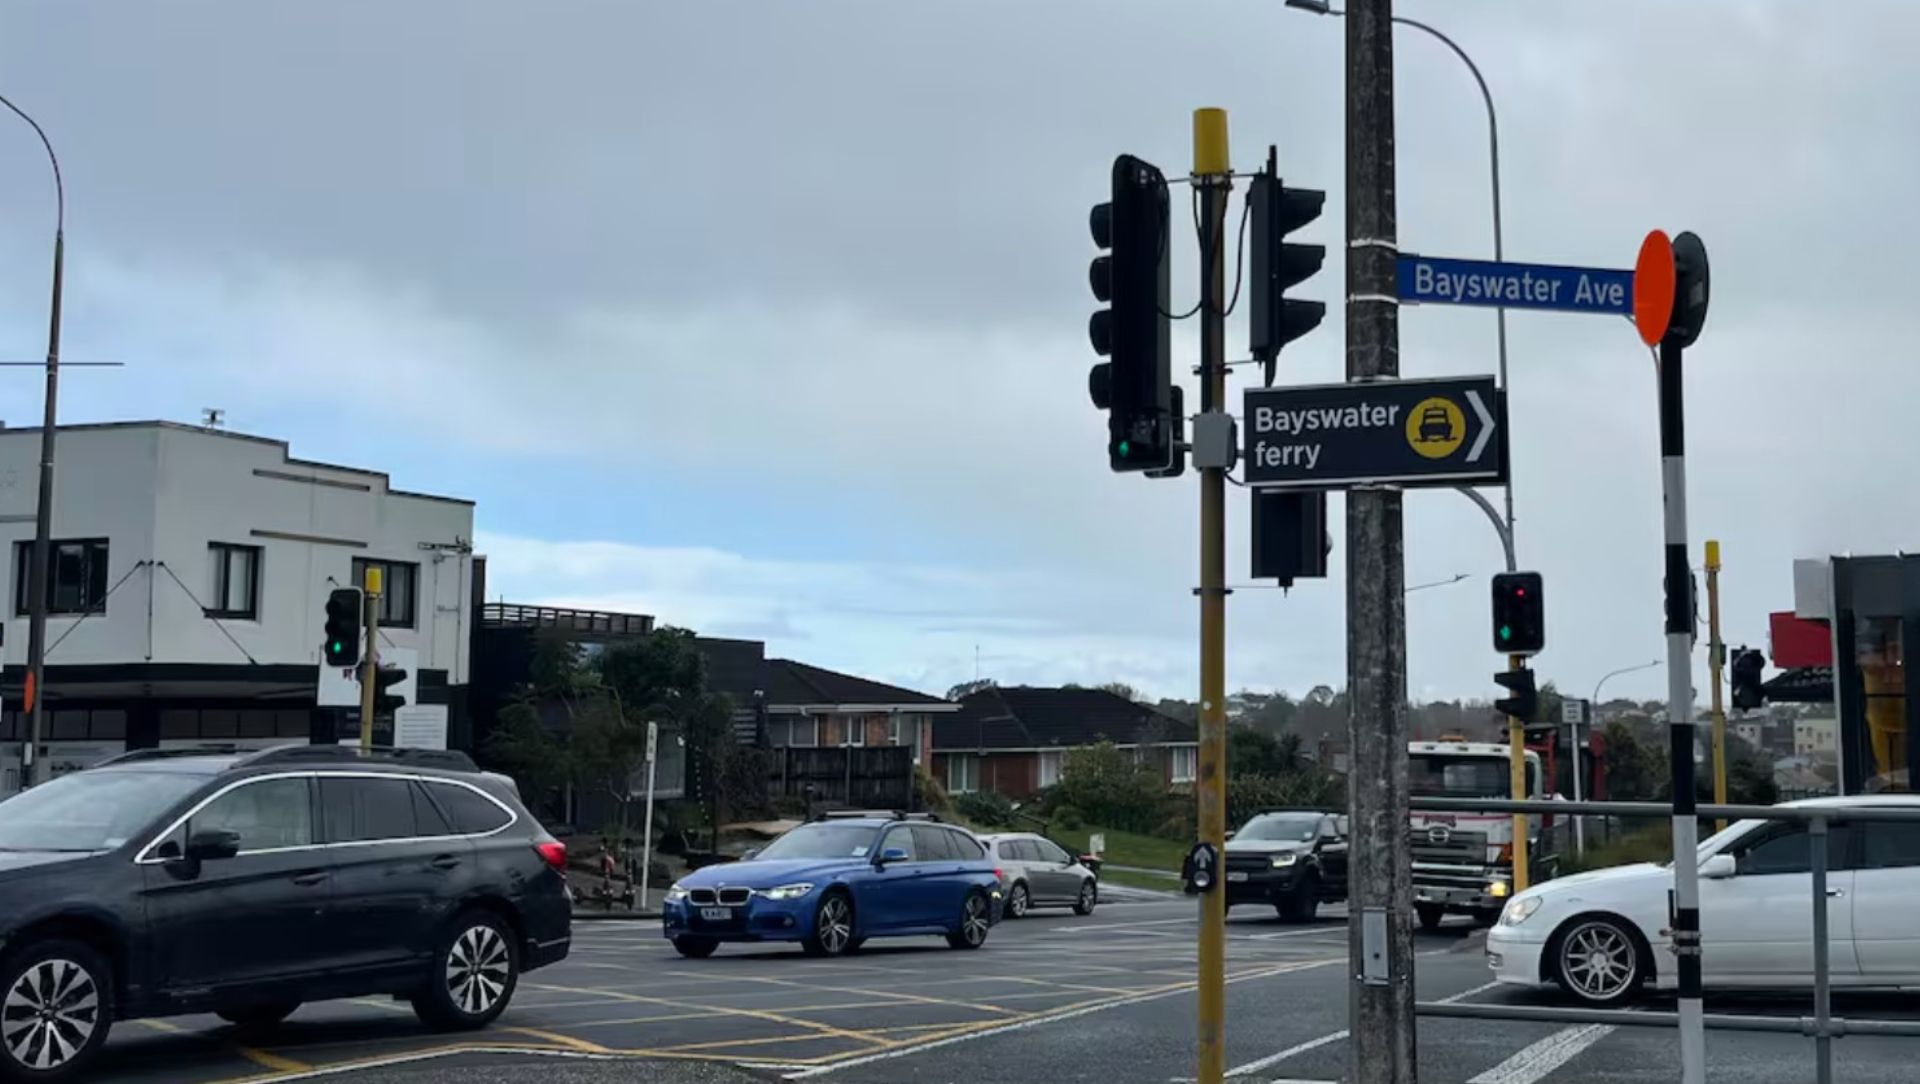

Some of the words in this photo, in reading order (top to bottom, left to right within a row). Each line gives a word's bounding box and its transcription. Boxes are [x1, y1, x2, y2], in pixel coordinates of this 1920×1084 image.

[1415, 263, 1561, 302] Bayswater
[1574, 273, 1625, 306] Ave
[1255, 402, 1399, 435] Bayswater
[1255, 441, 1321, 469] ferry
